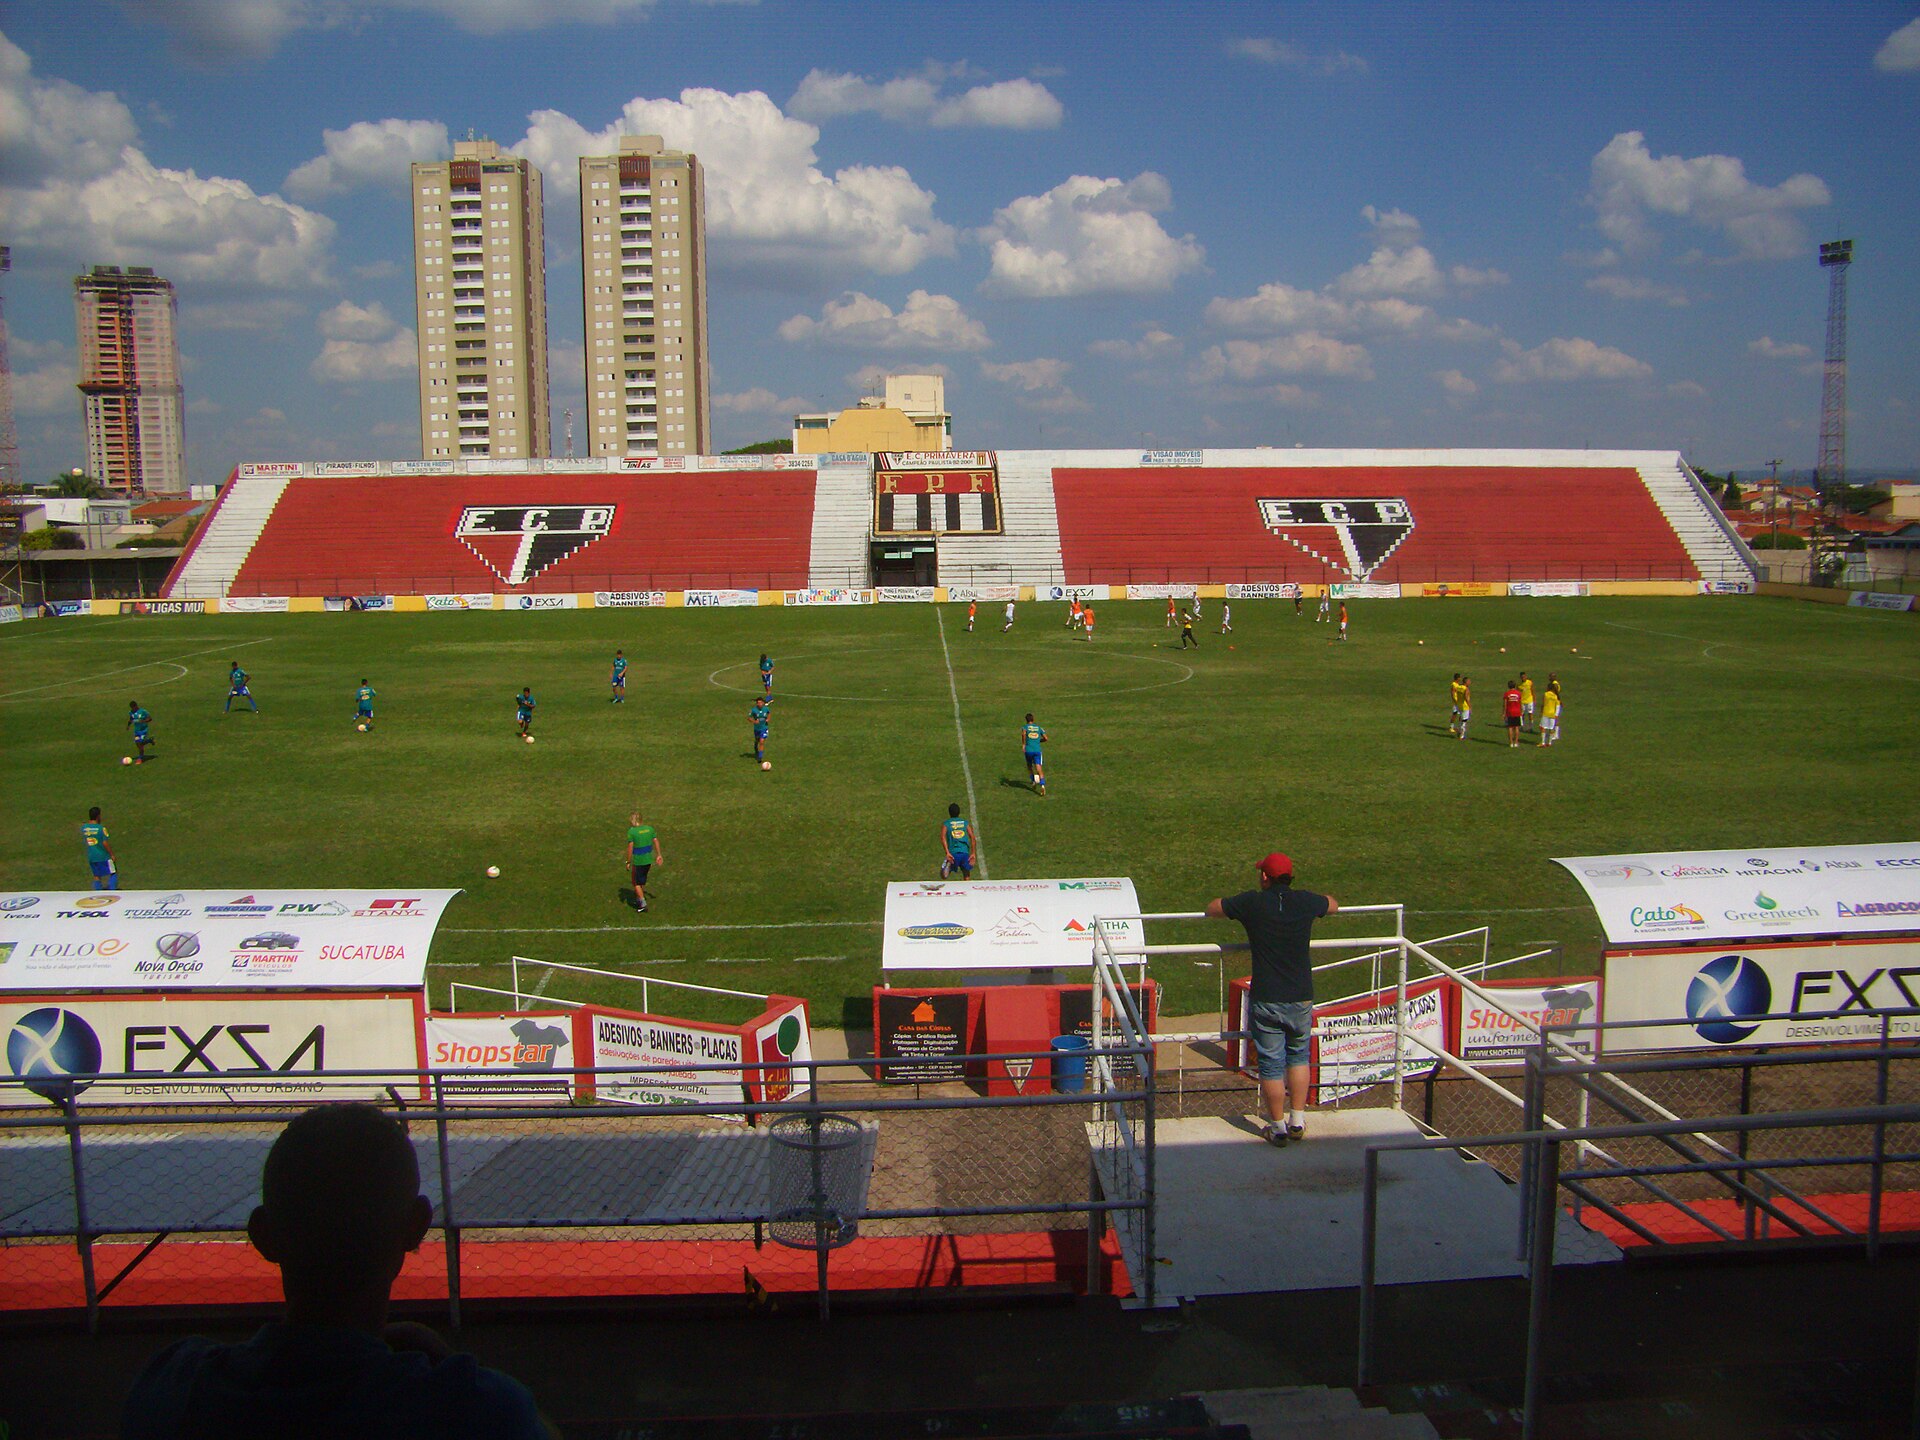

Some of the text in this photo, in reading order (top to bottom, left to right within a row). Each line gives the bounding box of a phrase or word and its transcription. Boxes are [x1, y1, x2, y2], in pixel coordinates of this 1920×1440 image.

[1241, 584, 1280, 592] ADESIVOS
[610, 592, 650, 600] ADESIVOS
[687, 596, 720, 606] META
[151, 602, 182, 614] LIGAS
[1735, 867, 1803, 878] HITACHI
[124, 909, 193, 917] TUBERFIL
[279, 903, 321, 913] PW
[353, 909, 426, 917] STANYL
[1723, 904, 1820, 922] Greentech
[1630, 905, 1677, 927] Cato
[29, 943, 95, 957] POLO
[319, 945, 405, 960] SUCATUBA
[252, 955, 299, 963] MARTINI
[134, 961, 164, 972] NOVA
[1786, 1022, 1910, 1038] DESENVOLVIMETO
[599, 1021, 738, 1062] ADESIVOS BANNERS PLACAS
[1468, 1031, 1541, 1046] uniformes
[436, 1042, 552, 1067] Shopstar
[641, 1053, 651, 1063] de
